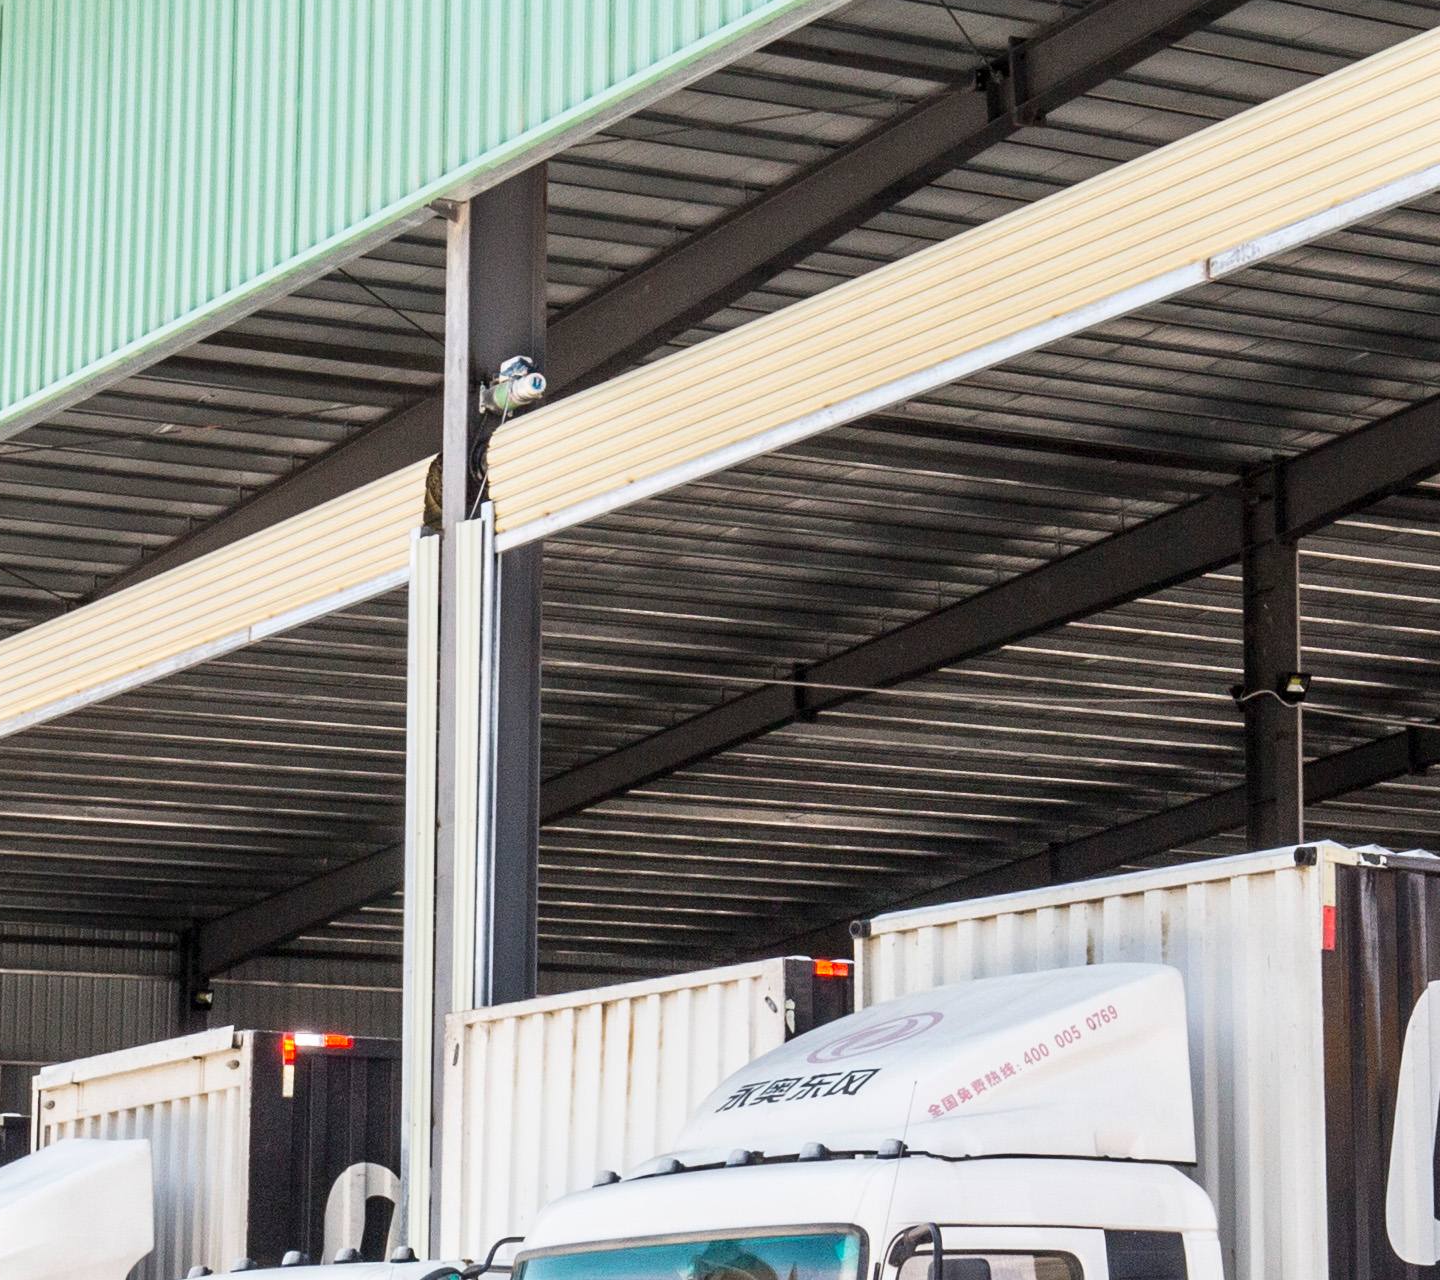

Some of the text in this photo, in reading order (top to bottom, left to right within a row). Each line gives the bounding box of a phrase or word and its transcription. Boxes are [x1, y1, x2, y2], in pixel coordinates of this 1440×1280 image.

[1023, 1043, 1049, 1066] 400
[1054, 1025, 1082, 1048] 005
[1086, 1005, 1118, 1031] 0769
